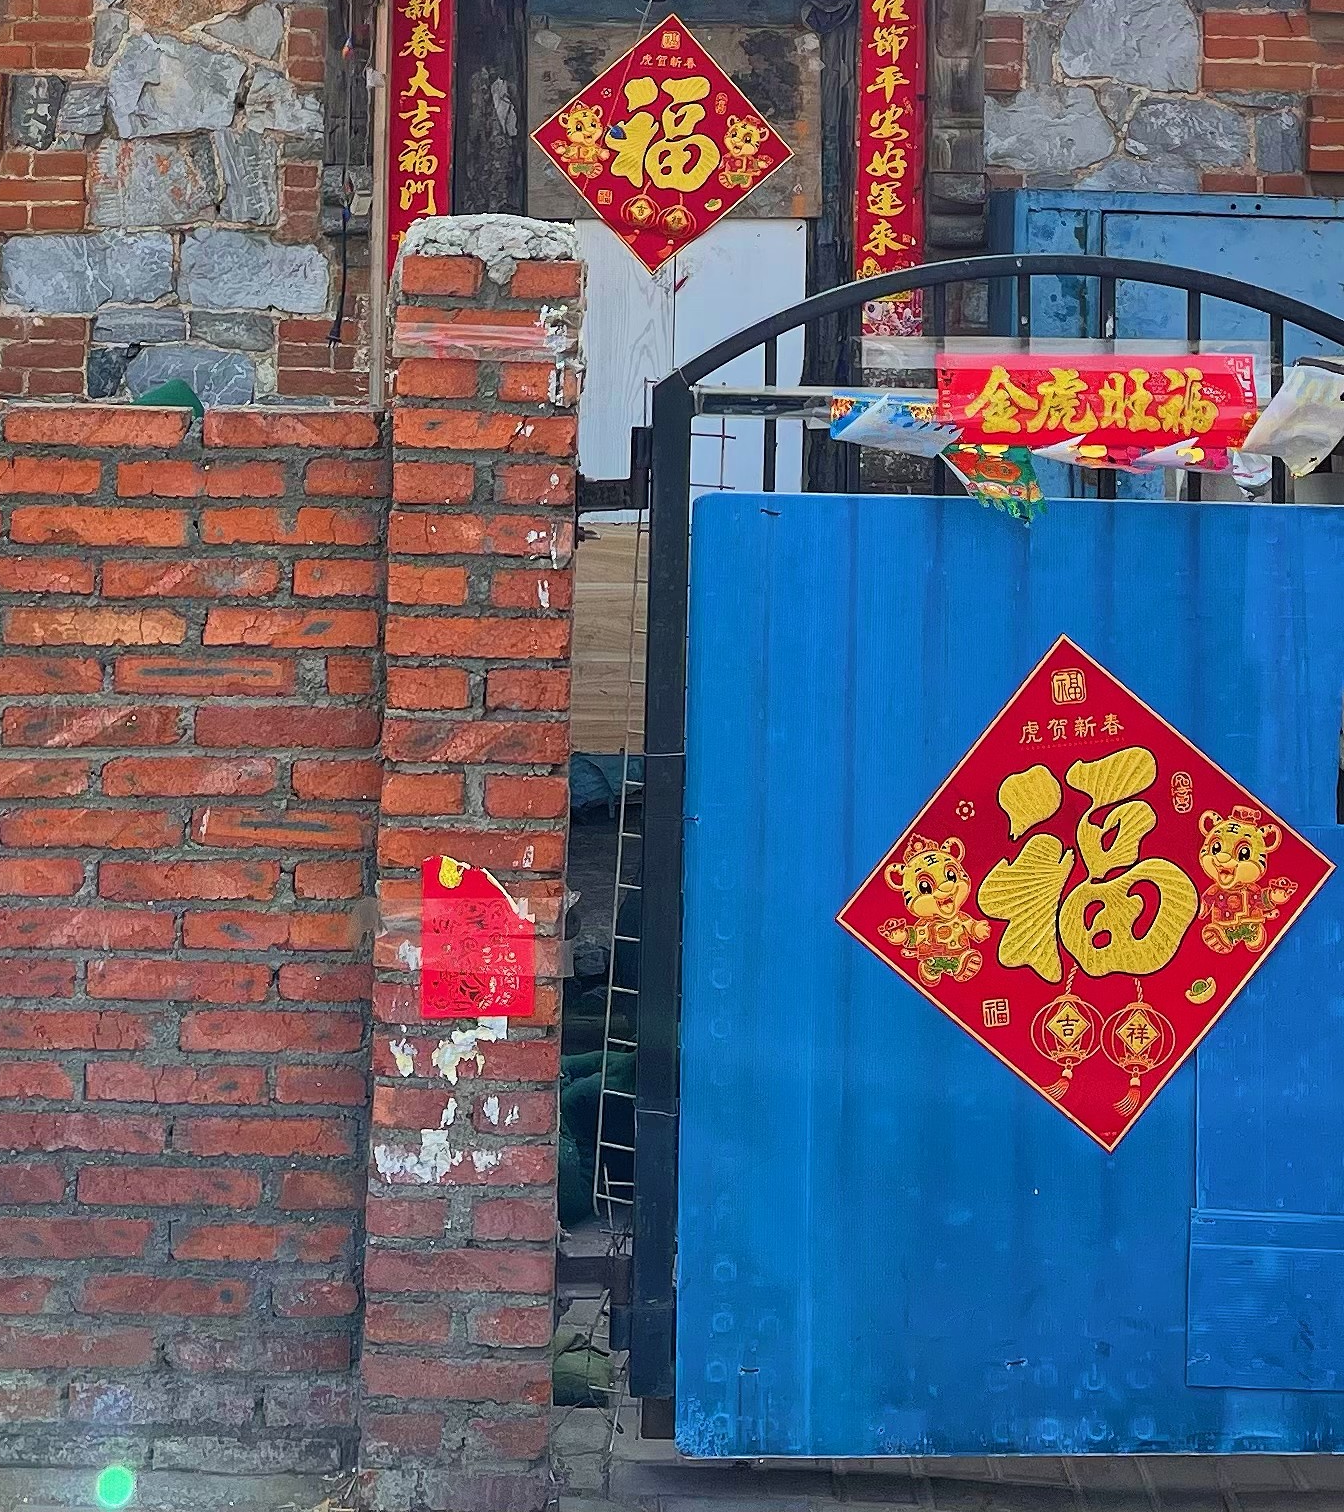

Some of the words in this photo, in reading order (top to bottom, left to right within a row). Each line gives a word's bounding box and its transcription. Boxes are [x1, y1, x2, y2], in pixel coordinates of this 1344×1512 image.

[605, 76, 721, 193] 福
[963, 363, 1220, 436] 金虎旺福
[1019, 712, 1126, 744] 虎贺新春
[977, 746, 1200, 984] 福
[1056, 1012, 1080, 1038] 吉
[1126, 1023, 1151, 1045] 祥
